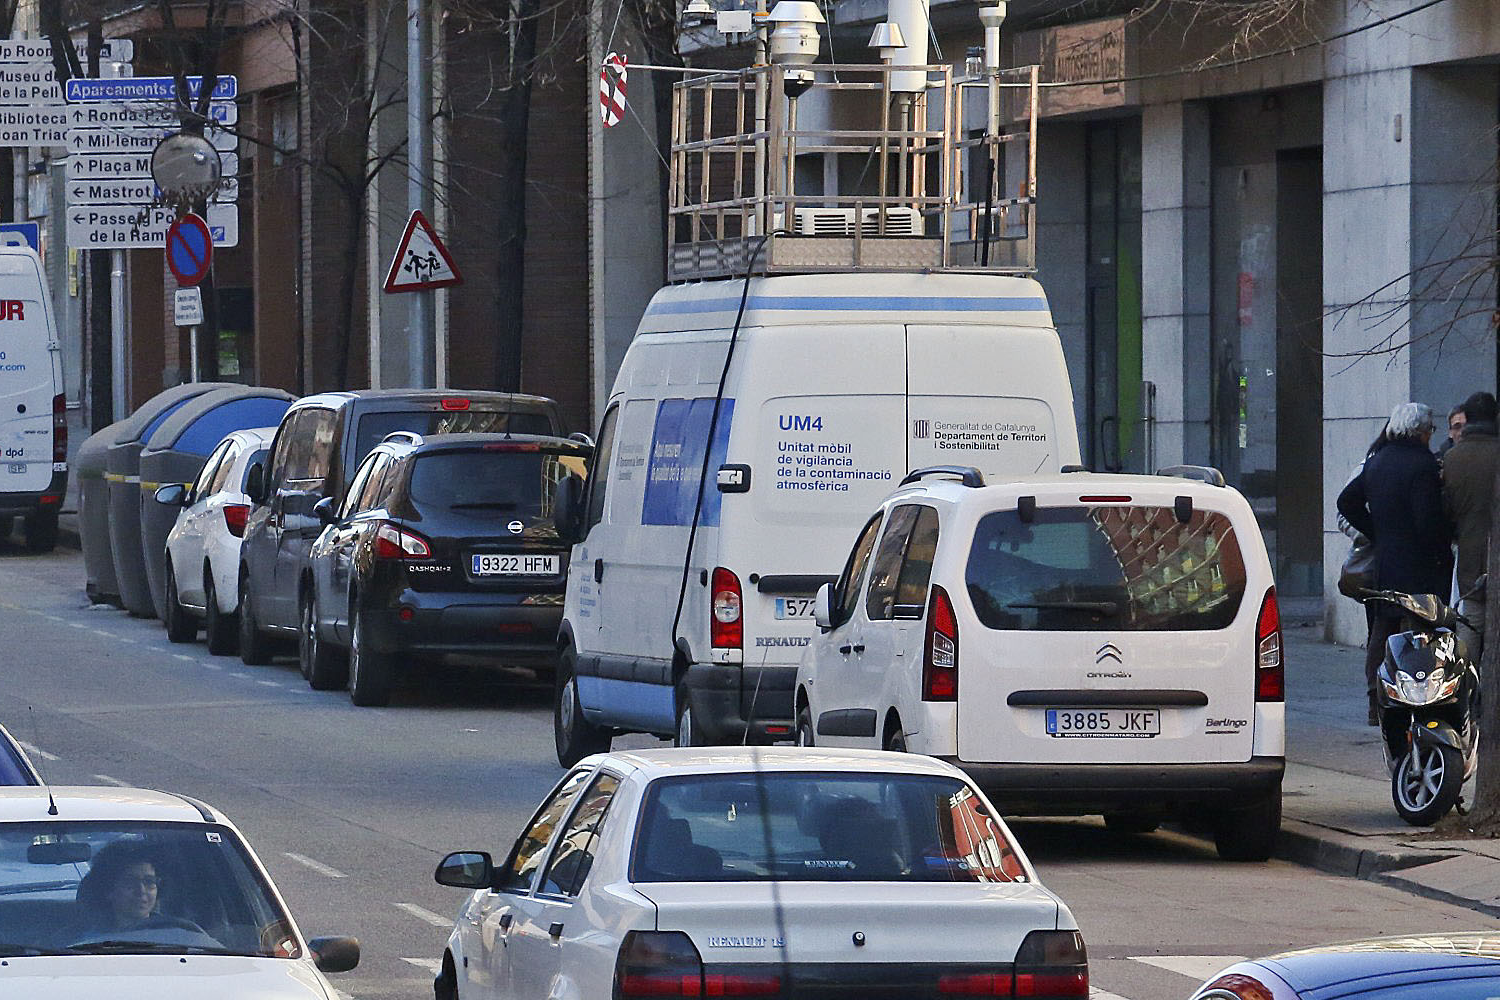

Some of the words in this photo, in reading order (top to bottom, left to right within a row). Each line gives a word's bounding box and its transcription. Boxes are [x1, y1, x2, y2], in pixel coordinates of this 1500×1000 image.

[14, 87, 27, 98] la
[31, 87, 58, 98] Pell
[71, 81, 168, 98] Aparcaments
[88, 159, 131, 175] Plaça
[89, 186, 150, 198] Mastrot
[90, 230, 108, 242] de
[112, 230, 126, 242] la
[779, 415, 823, 431] UM4
[934, 422, 979, 431] Generalitat
[982, 423, 993, 431] de
[994, 423, 1036, 433] Catalunya
[934, 432, 995, 442] Departament
[997, 432, 1009, 441] de
[1011, 433, 1046, 441] Territori
[5, 447, 24, 458] dpd
[778, 442, 815, 453] Unitat
[818, 444, 852, 454] mòbil
[939, 442, 1000, 451] Sostenibilitat
[777, 455, 793, 464] de
[796, 455, 853, 468] vigilància
[777, 467, 792, 477] de
[795, 467, 806, 478] la
[809, 469, 892, 481] contaminació
[776, 480, 849, 492] atmosfèrica
[482, 557, 519, 572] 9322
[524, 557, 552, 572] HFM
[786, 599, 817, 617] 572
[1061, 712, 1111, 730] 3885
[1118, 712, 1154, 730] JKF
[1206, 718, 1247, 728] Berlingo
[708, 936, 766, 948] RENAULT
